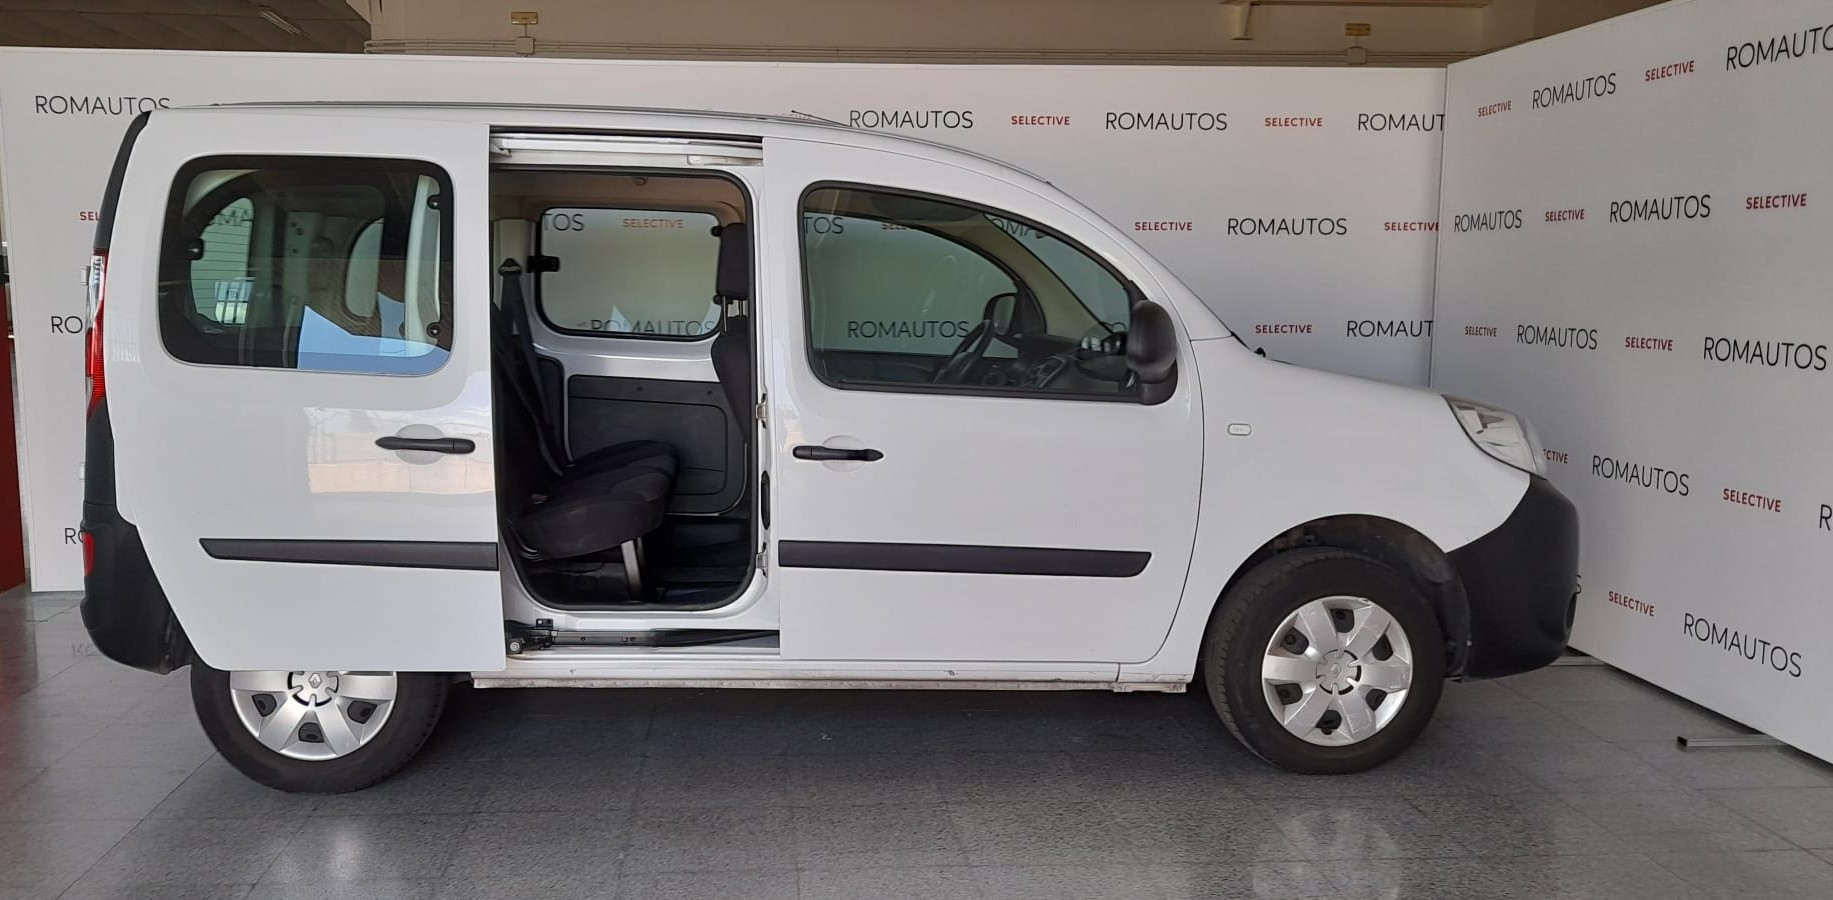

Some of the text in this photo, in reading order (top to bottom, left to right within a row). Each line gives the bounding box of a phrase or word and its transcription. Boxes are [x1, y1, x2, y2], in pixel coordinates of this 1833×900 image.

[1477, 100, 1512, 117] SELECTIVE
[1532, 73, 1616, 110] ROMAUTOS
[1645, 60, 1694, 81] SELECTIVE
[849, 110, 1445, 131] ROMAUTOS SELECTIVE ROMAUTOS SELECTIVE ROMAUT
[622, 217, 684, 229] SELECTIVE
[1453, 193, 1807, 232] ROMAUTOS SELECTIVE ROMAUTOS SELECTIVE
[1134, 221, 1193, 231] SELECTIVE
[1227, 217, 1348, 236] ROMAUTOS
[50, 315, 83, 334] RO
[847, 320, 971, 339] ROMAUTOS
[1255, 320, 1433, 337] SELECTIVE ROMAUT
[1464, 325, 1827, 371] SELECTIVE ROMAUTOS SELECTIVE ROMAUTOS
[1592, 455, 1690, 496] ROMAUTOS
[1722, 488, 1782, 512] SELECTIVE
[1608, 590, 1802, 677] SELECTIVE ROMAUTOS
